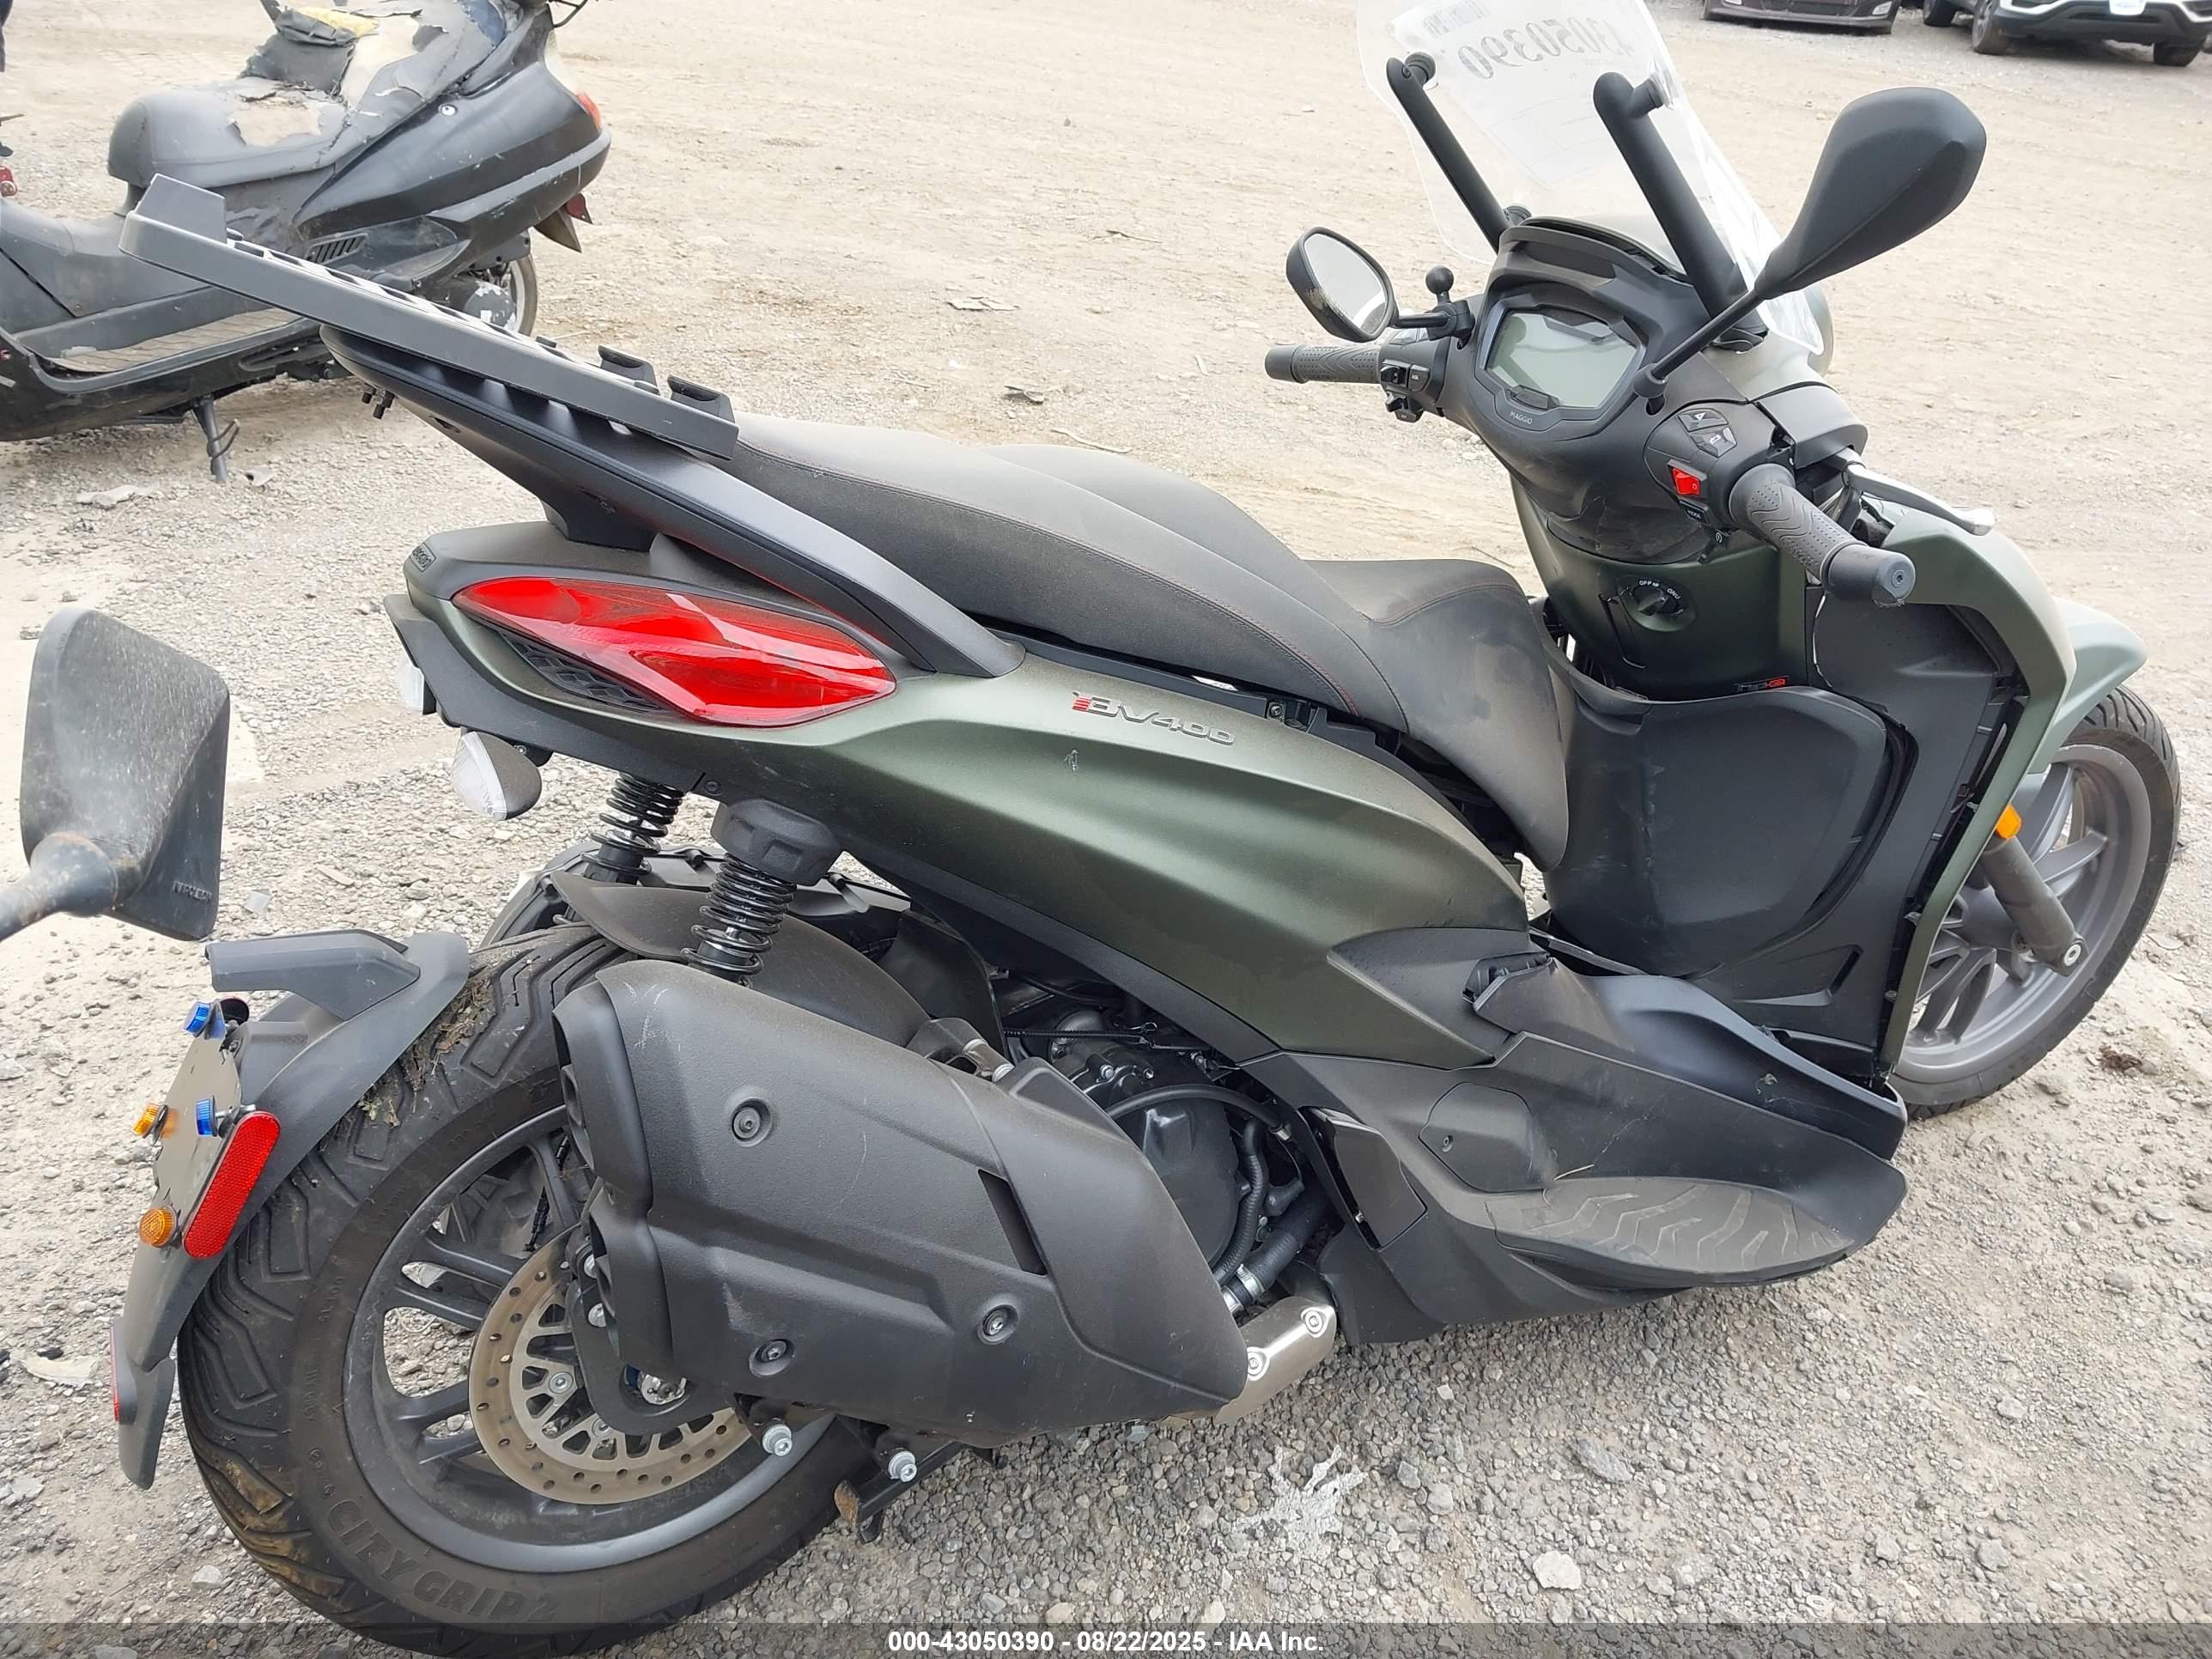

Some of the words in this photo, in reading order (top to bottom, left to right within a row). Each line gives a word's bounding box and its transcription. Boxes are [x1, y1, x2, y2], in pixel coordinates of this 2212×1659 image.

[1510, 410, 1533, 424] PIAGGIO
[1079, 694, 1236, 745] BV400
[328, 1498, 419, 1581] CITY
[412, 1570, 529, 1620] GRIP
